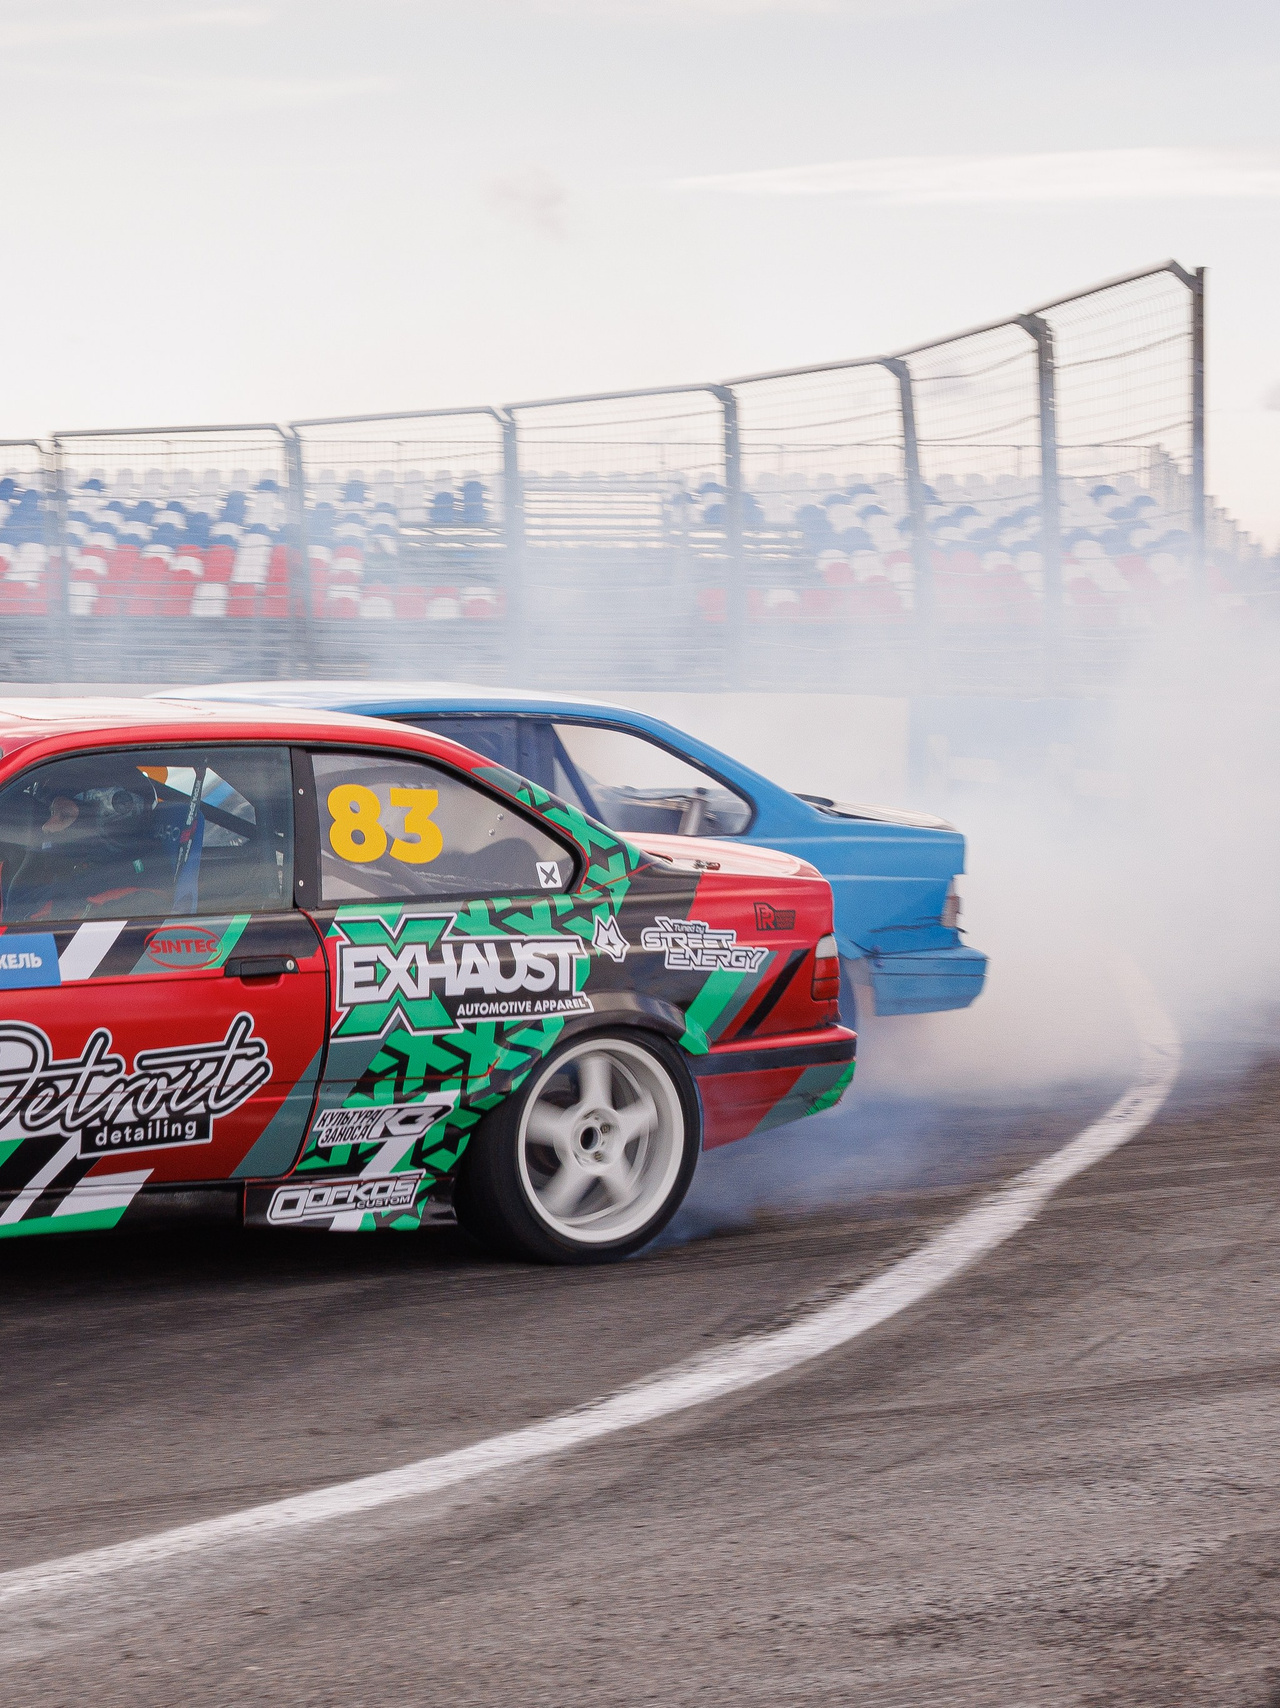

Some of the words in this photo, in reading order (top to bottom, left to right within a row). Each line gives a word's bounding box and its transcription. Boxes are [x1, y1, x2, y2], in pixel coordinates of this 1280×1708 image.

[327, 784, 444, 864] 83
[673, 923, 695, 933] Tuned
[695, 924, 705, 934] by
[149, 938, 218, 955] SINTEC
[644, 930, 734, 950] STREET
[669, 948, 765, 969] ENERGY
[340, 936, 582, 1008] EXHAUST
[456, 1000, 532, 1017] AUTOMOTIVE
[534, 999, 586, 1013] APPAREL
[317, 1109, 380, 1128] КУЛЬТУРА
[95, 1120, 197, 1146] detailing
[320, 1125, 369, 1144] ЗАНОСА
[356, 1195, 411, 1210] CUSTOM
